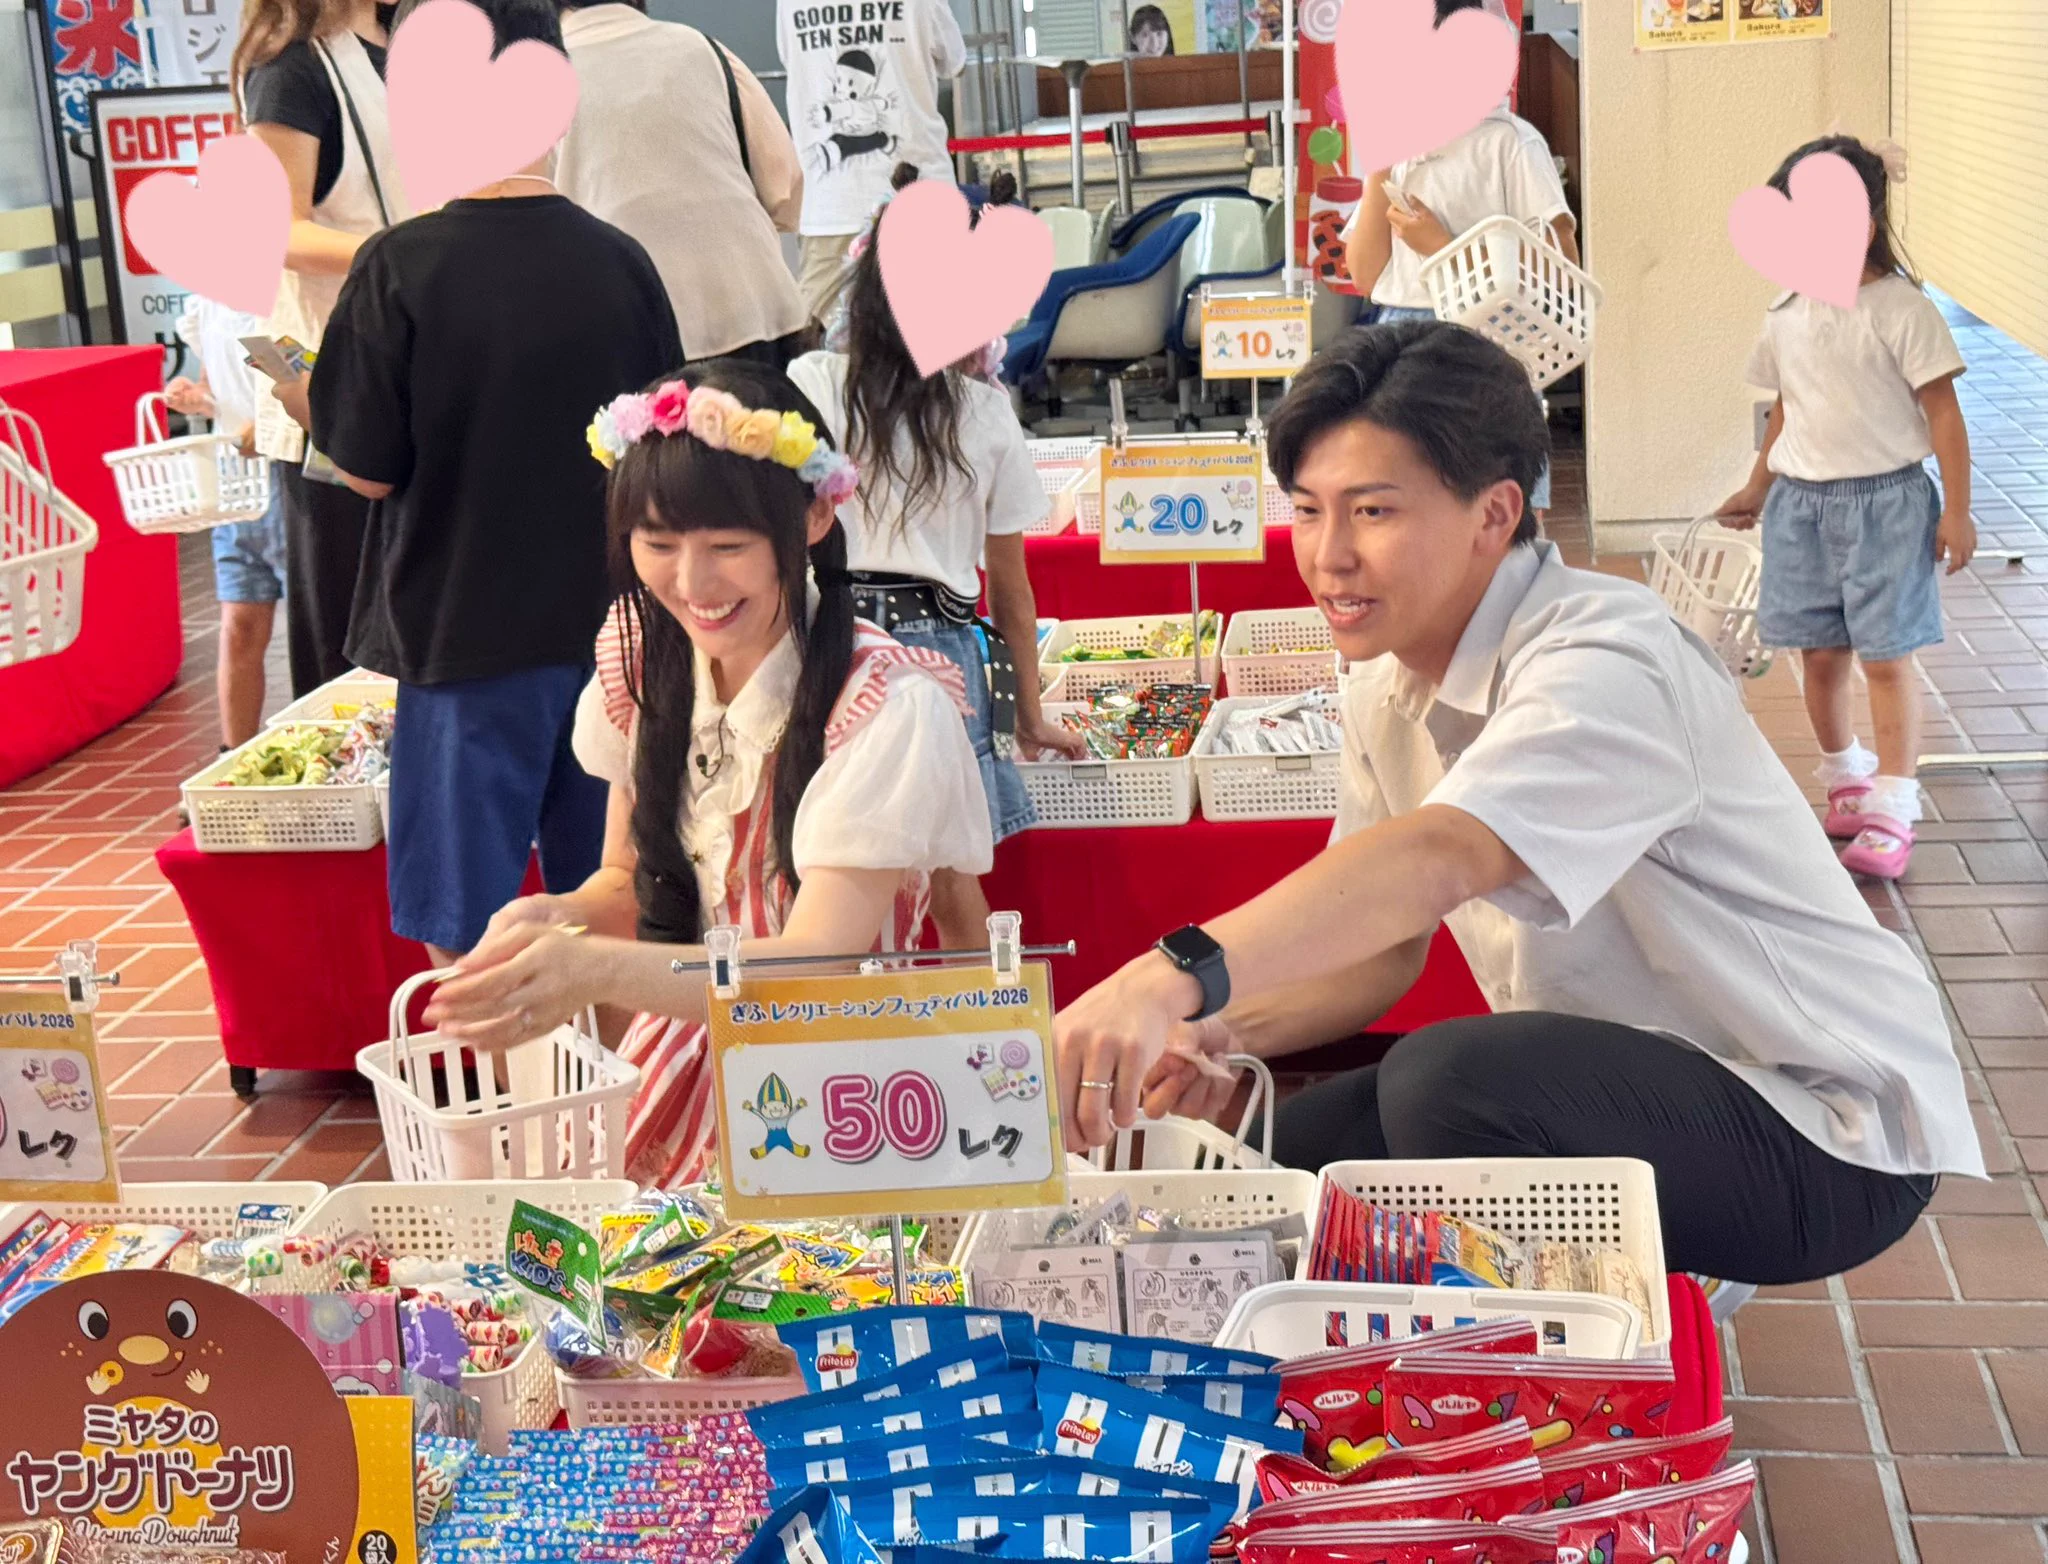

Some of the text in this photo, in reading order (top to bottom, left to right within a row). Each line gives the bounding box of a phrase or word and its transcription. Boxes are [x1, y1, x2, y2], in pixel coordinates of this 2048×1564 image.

[794, 1, 904, 30] GOOD BYE
[797, 28, 833, 51] TEN
[838, 24, 884, 46] SAN
[1236, 330, 1297, 360] 10 レク
[1148, 493, 1244, 536] 20 レク
[821, 1069, 1024, 1165] 50 レク
[18, 1129, 78, 1160] レク
[84, 1404, 219, 1446] ミヤタの
[7, 1446, 294, 1514] ヤングドーナツ
[142, 1514, 241, 1547] Doughnut
[365, 1533, 388, 1551] 20
